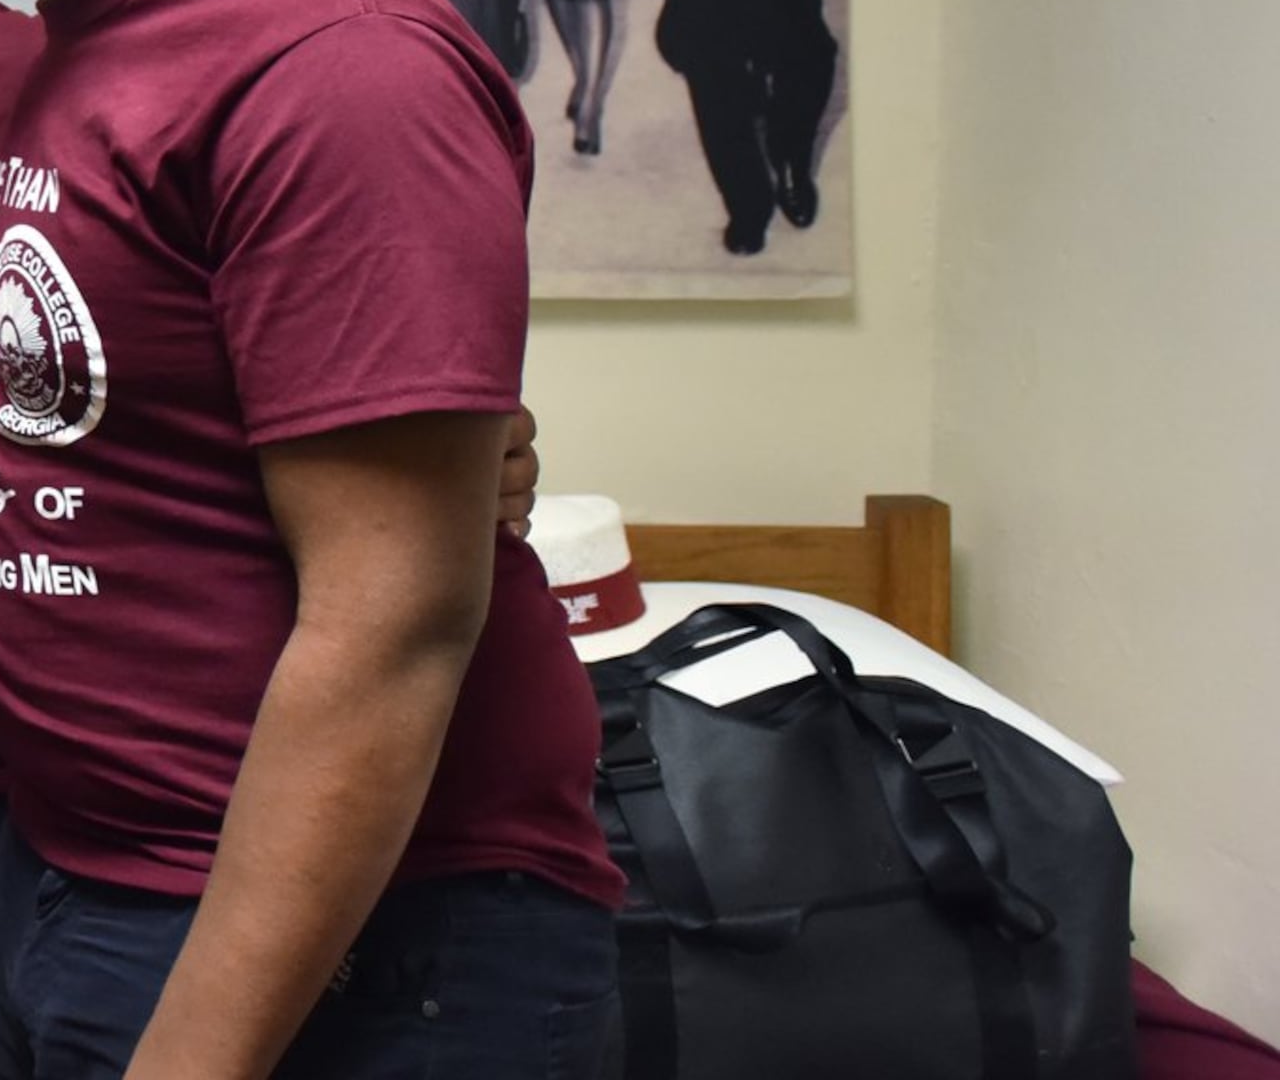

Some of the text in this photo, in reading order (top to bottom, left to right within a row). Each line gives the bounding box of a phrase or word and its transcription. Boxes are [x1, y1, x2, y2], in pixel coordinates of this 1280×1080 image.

[21, 250, 82, 345] COLLEGE
[34, 485, 85, 521] OF
[19, 552, 100, 596] MEN
